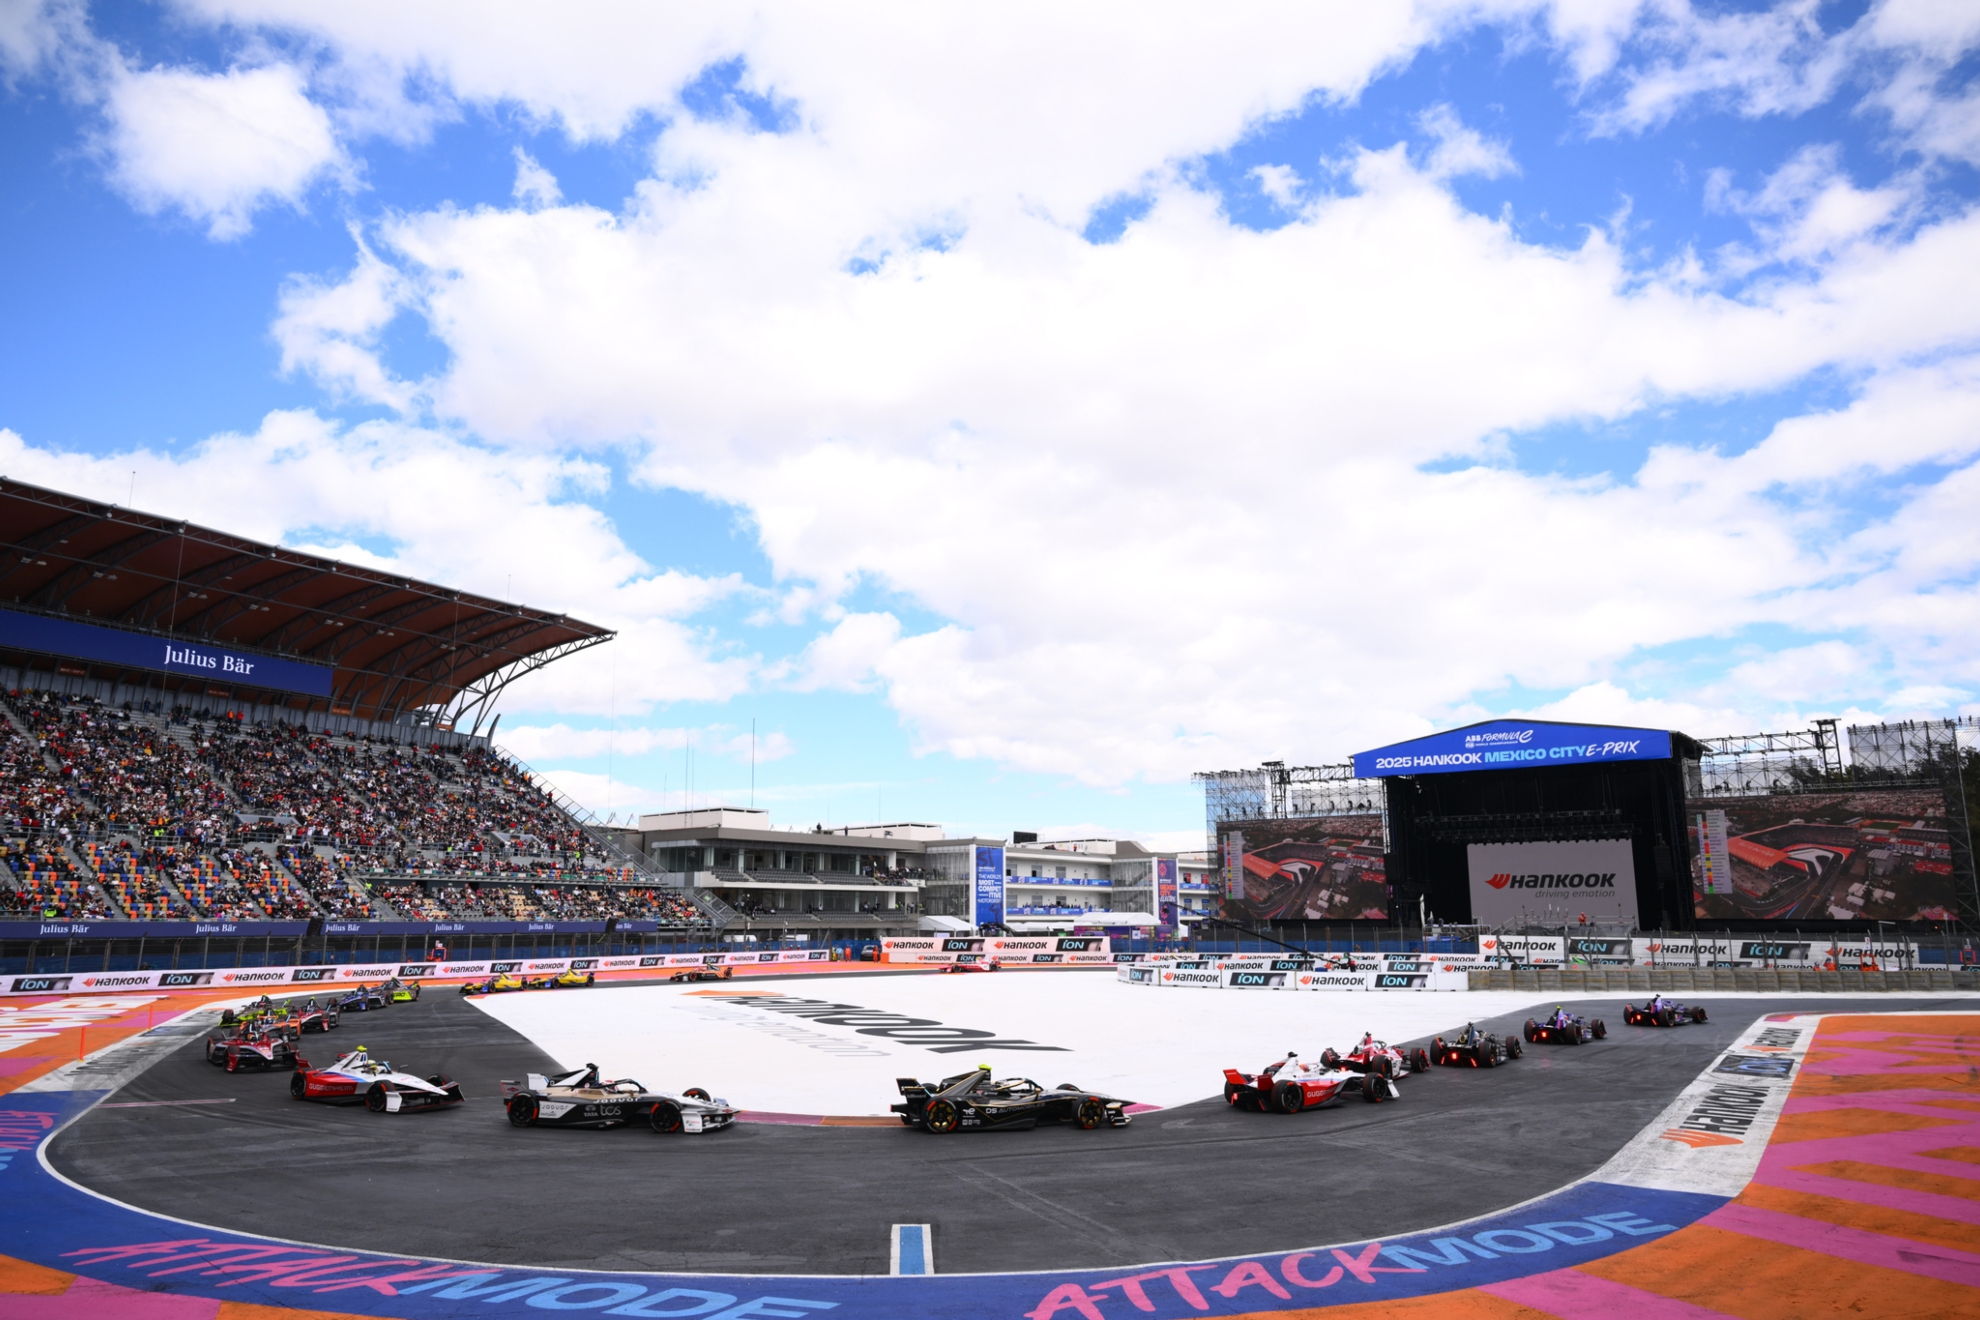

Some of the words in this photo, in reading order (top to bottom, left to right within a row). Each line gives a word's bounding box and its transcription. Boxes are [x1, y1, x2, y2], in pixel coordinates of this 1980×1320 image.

[164, 645, 216, 669] Julius
[222, 654, 254, 675] Bär
[1482, 731, 1520, 742] FORMULA
[1376, 756, 1412, 769] 2025
[1414, 752, 1482, 767] HANKOOK
[1484, 749, 1546, 763] MEXICO
[1549, 745, 1586, 758] CITY
[1586, 740, 1640, 756] E-PRIX
[1535, 890, 1570, 899] driving
[1572, 889, 1615, 898] emotion
[40, 925, 68, 935] Julius
[72, 925, 89, 933] Bär
[196, 924, 218, 933] Julius
[220, 924, 236, 932] Bär
[326, 924, 345, 932] Julius
[948, 941, 968, 949] iON
[1062, 940, 1084, 949] iON
[1238, 973, 1264, 984] iON
[1382, 975, 1407, 985] iON
[20, 979, 50, 990] iON
[600, 1105, 621, 1116] tcs
[998, 1102, 1045, 1113] AUTOMOBILES
[59, 1238, 504, 1296] ATTACK
[1023, 1242, 1426, 1320] ATTACK
[1382, 1211, 1681, 1270] MODE
